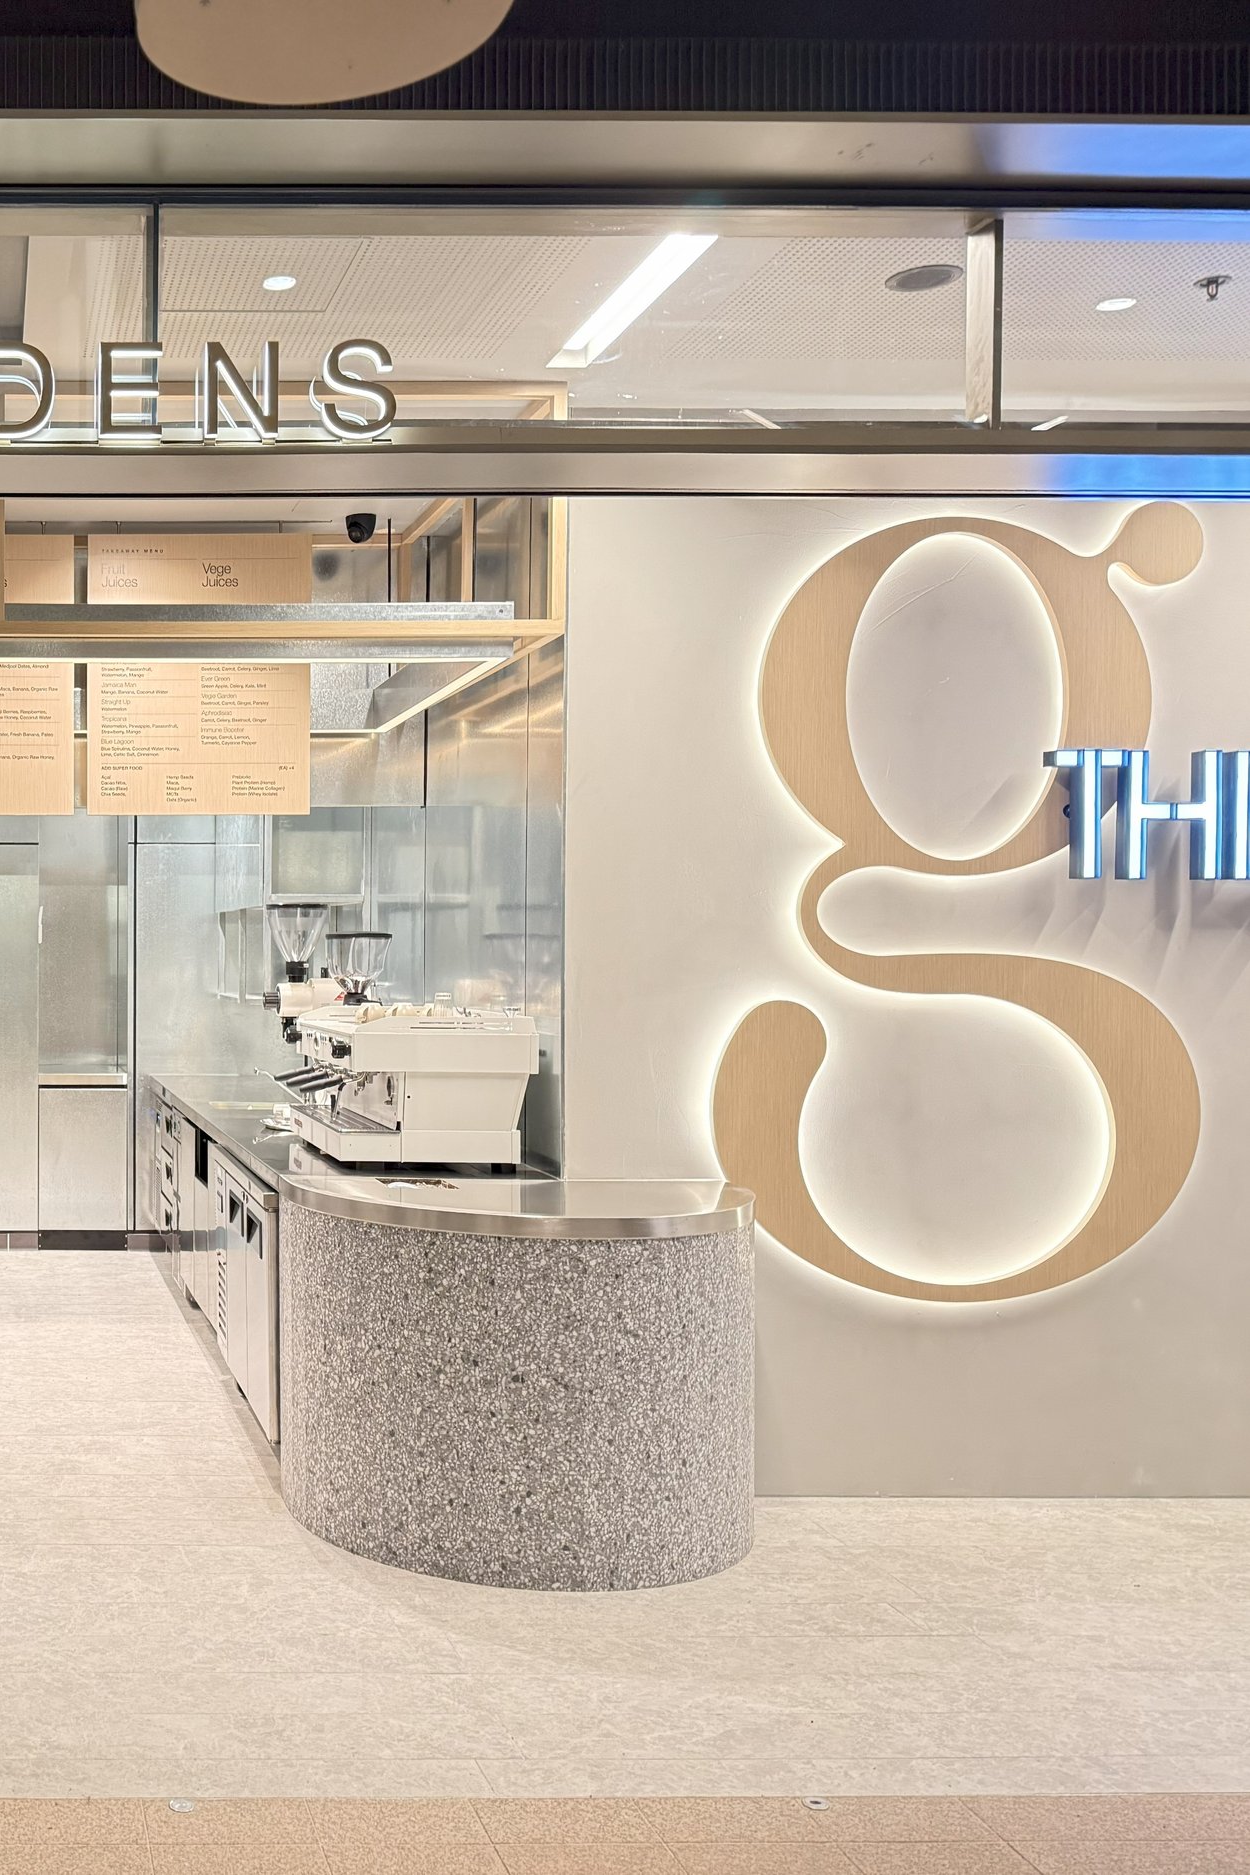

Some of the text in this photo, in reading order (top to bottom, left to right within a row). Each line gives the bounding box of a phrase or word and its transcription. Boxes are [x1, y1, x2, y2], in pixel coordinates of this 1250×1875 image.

[101, 564, 125, 575] Fruit
[202, 563, 231, 576] Vege
[102, 576, 138, 588] Juices
[202, 576, 238, 588] Juices
[1043, 749, 1250, 880] TH
